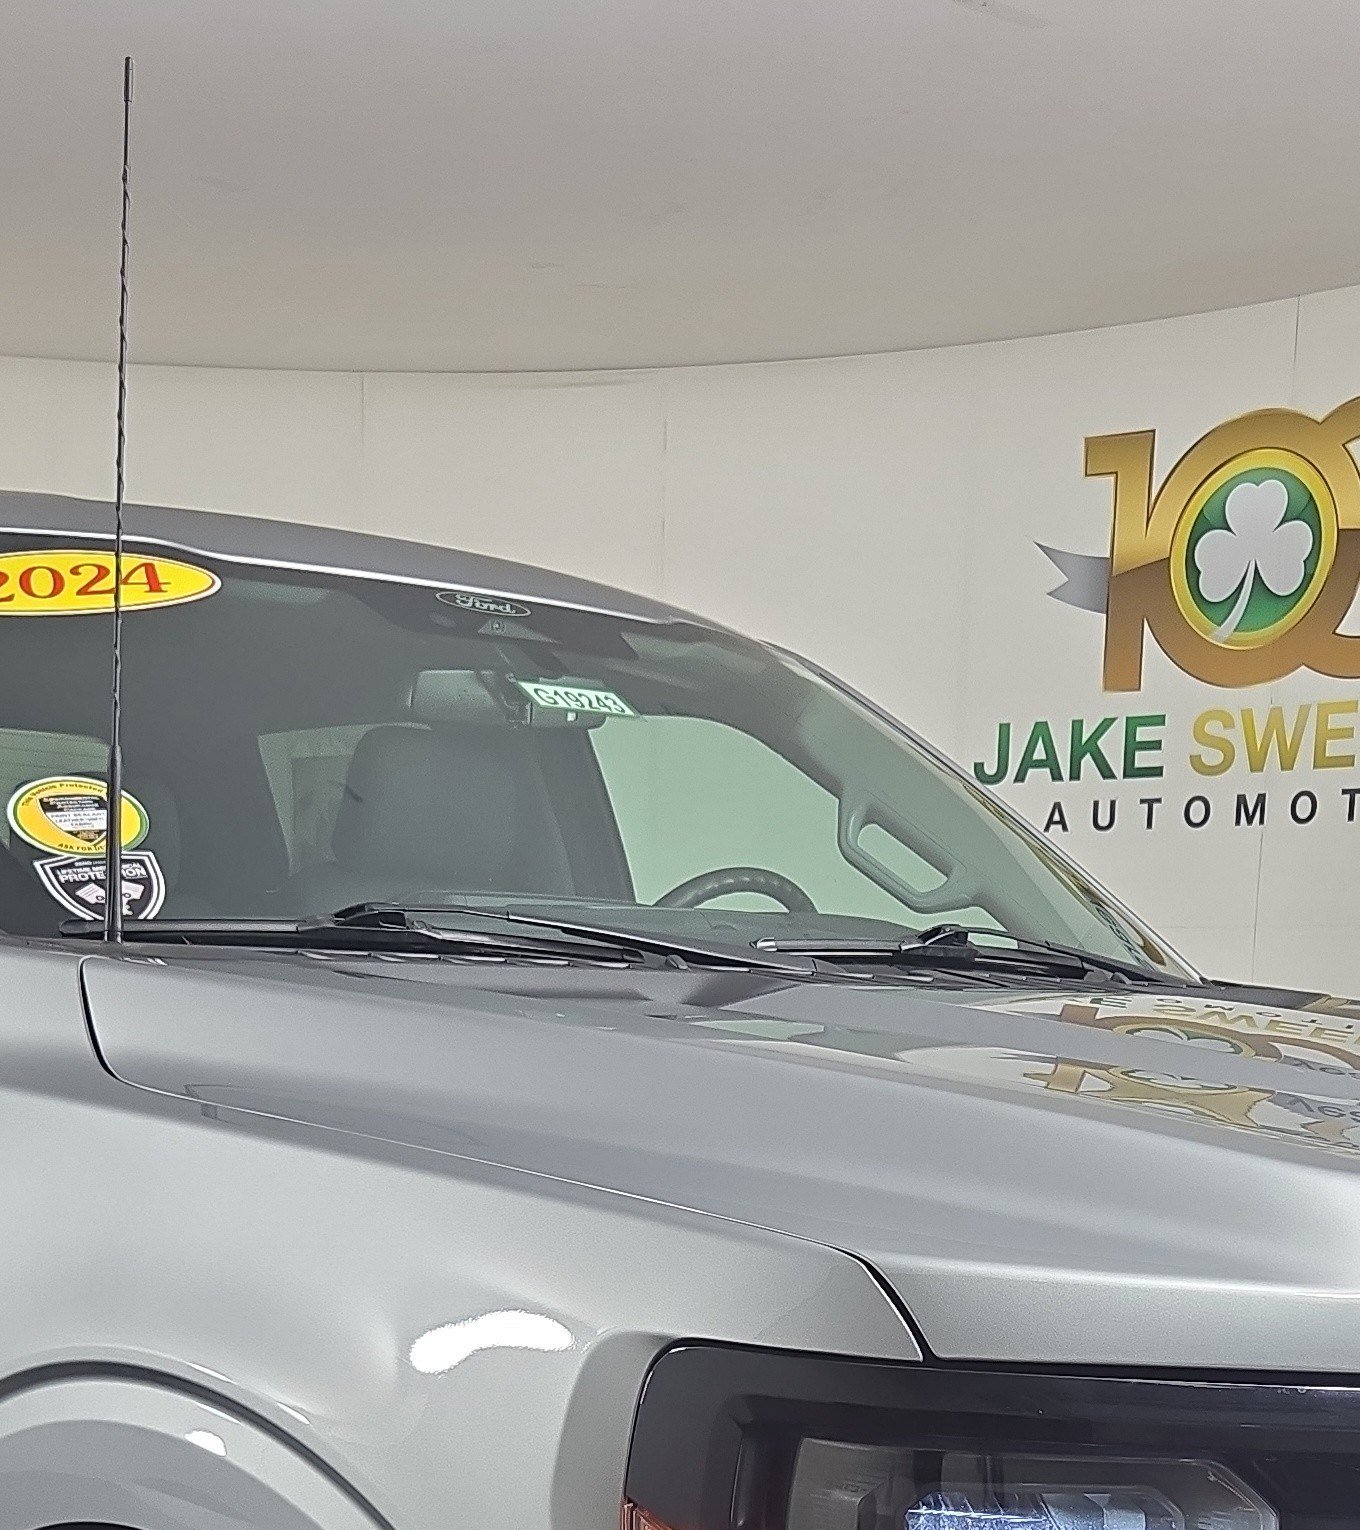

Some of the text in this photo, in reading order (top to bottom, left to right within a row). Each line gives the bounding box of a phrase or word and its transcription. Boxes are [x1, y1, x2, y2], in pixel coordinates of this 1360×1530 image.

[455, 593, 516, 614] Ford
[533, 687, 626, 714] G19243
[972, 714, 1167, 787] JAKE
[58, 868, 148, 883] PROTEION
